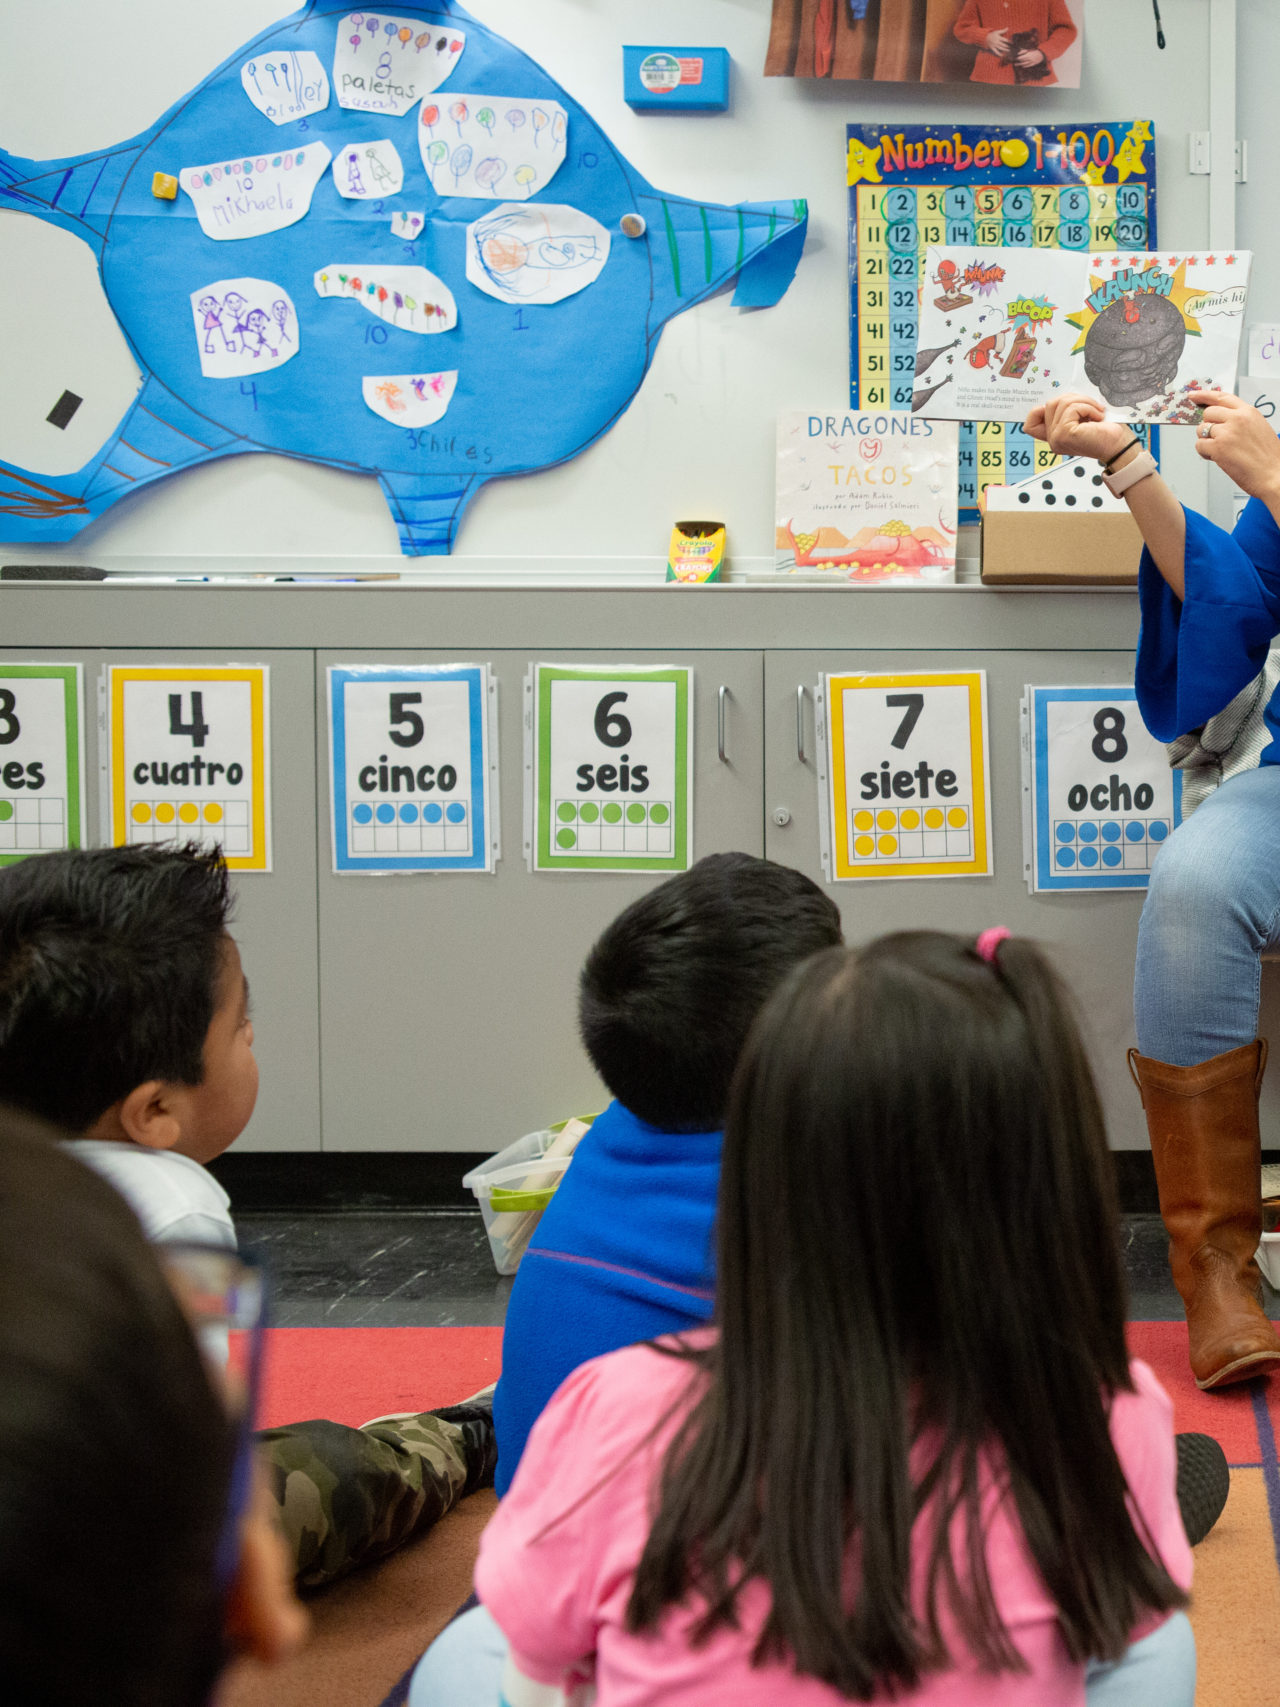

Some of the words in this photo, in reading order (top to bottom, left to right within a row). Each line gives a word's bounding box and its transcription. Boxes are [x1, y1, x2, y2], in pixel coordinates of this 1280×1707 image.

[375, 51, 392, 79] 8
[342, 73, 415, 99] paletas
[297, 119, 309, 132] 3
[578, 152, 598, 169] 10
[1034, 129, 1115, 170] 1-100
[236, 177, 254, 193] 10
[373, 201, 384, 214] 2
[870, 194, 876, 210] 1
[896, 194, 908, 210] 2
[926, 195, 937, 210] 3
[954, 194, 966, 210] 4
[984, 195, 994, 210] 5
[1012, 194, 1023, 210] 6
[1041, 194, 1051, 210] 7
[1069, 194, 1080, 210] 8
[1097, 193, 1107, 208] 9
[1122, 192, 1139, 208] 10
[868, 227, 880, 242] 11
[895, 227, 910, 242] 12
[924, 227, 940, 242] 13
[952, 227, 968, 242] 14
[981, 227, 997, 242] 15
[1009, 226, 1026, 241] 16
[1038, 227, 1054, 242] 17
[1067, 226, 1083, 241] 18
[1095, 226, 1111, 241] 19
[1120, 224, 1143, 241] 20
[866, 259, 883, 275] 21
[893, 259, 914, 275] 22
[866, 292, 883, 307] 31
[893, 292, 914, 308] 32
[1087, 266, 1175, 314] KRUNCH
[513, 309, 529, 331] 1
[1007, 299, 1053, 323] BLOOP
[364, 325, 388, 344] 10
[866, 324, 883, 339] 41
[893, 324, 915, 339] 42
[867, 356, 884, 371] 51
[893, 356, 915, 371] 52
[240, 382, 258, 411] 4
[867, 387, 884, 403] 61
[808, 416, 933, 437] DRAGONES
[981, 450, 1002, 467] 85
[1009, 450, 1031, 467] 86
[1038, 450, 1059, 467] 87
[827, 465, 913, 487] TACOS
[168, 691, 210, 748] 4
[387, 692, 425, 748] 5
[593, 691, 633, 748] 6
[885, 693, 925, 750] 7
[1090, 707, 1128, 763] 8
[133, 755, 243, 788] cuatro
[358, 755, 457, 793] cinco
[575, 754, 649, 794] seis
[859, 760, 959, 801] siete
[1067, 774, 1155, 814] ocho
